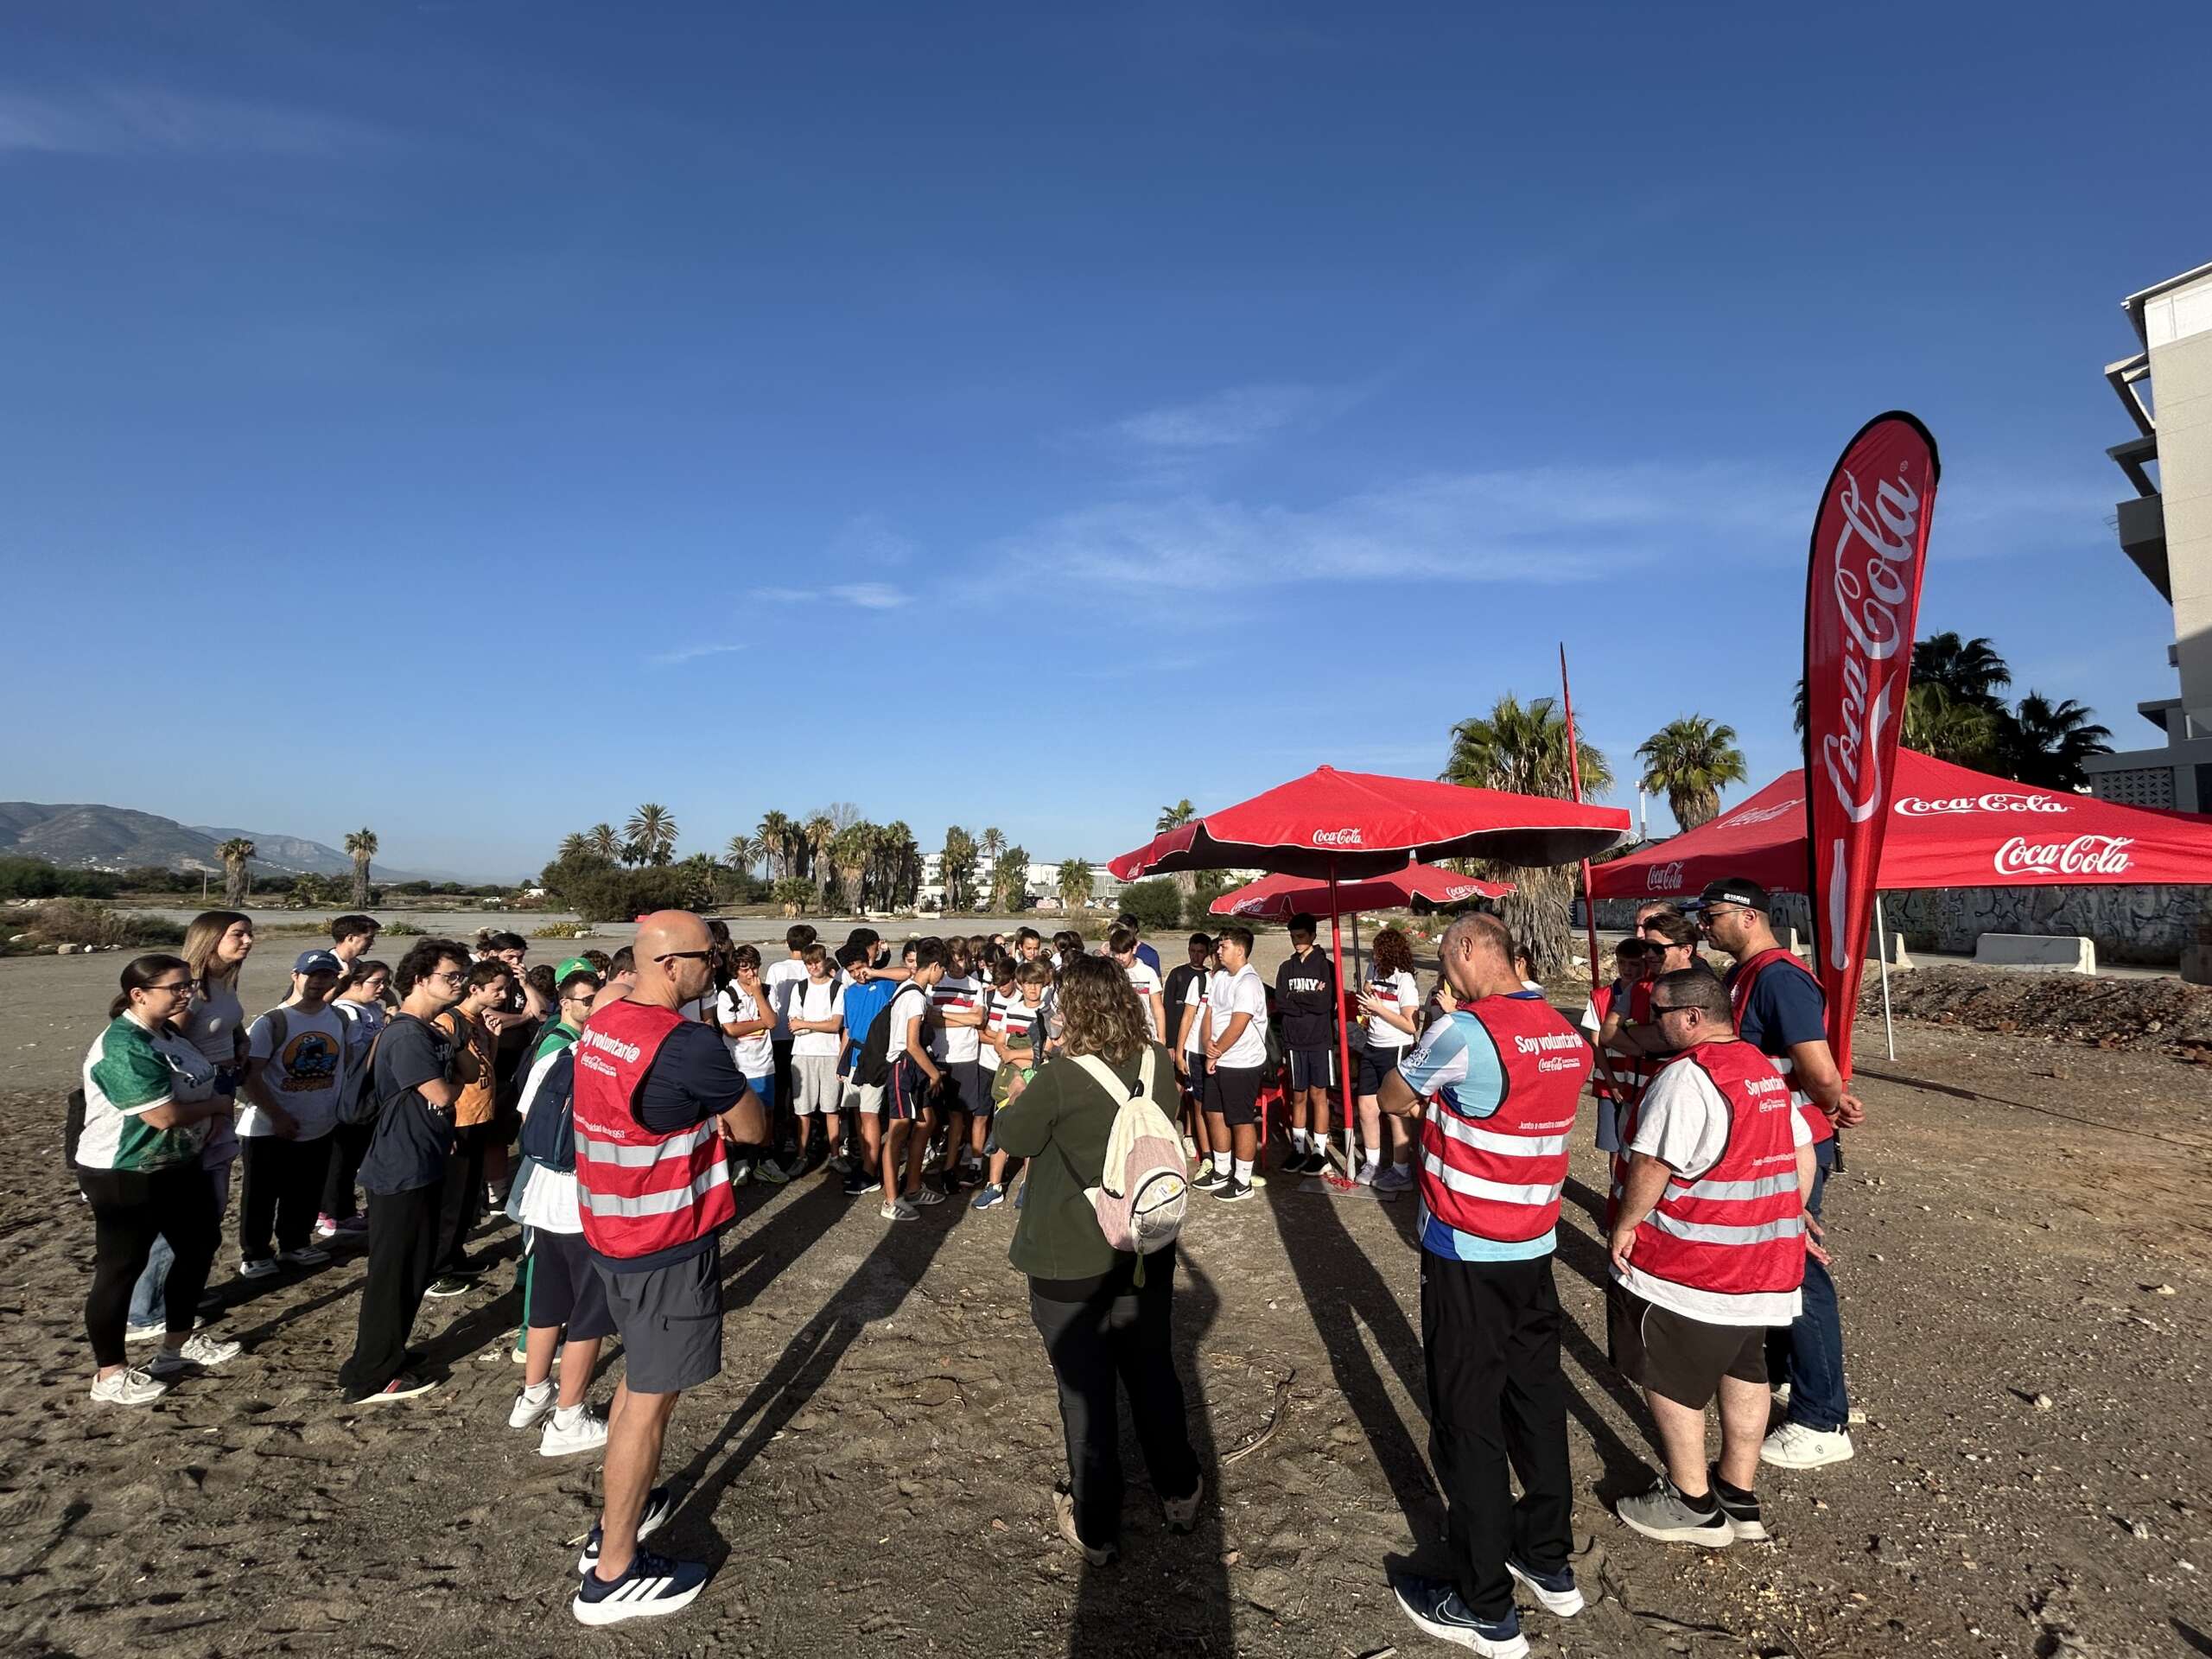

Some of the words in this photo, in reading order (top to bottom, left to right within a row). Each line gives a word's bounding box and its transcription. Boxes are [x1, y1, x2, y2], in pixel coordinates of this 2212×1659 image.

[1823, 468, 1920, 823] Coca-Cola
[1894, 793, 2069, 817] Coca-Cola
[1312, 828, 1362, 845] Coca-Cola
[1993, 835, 2134, 875] Coca-Cola
[1647, 861, 1684, 891] Coca-Cola
[1515, 1035, 1540, 1055] Soy
